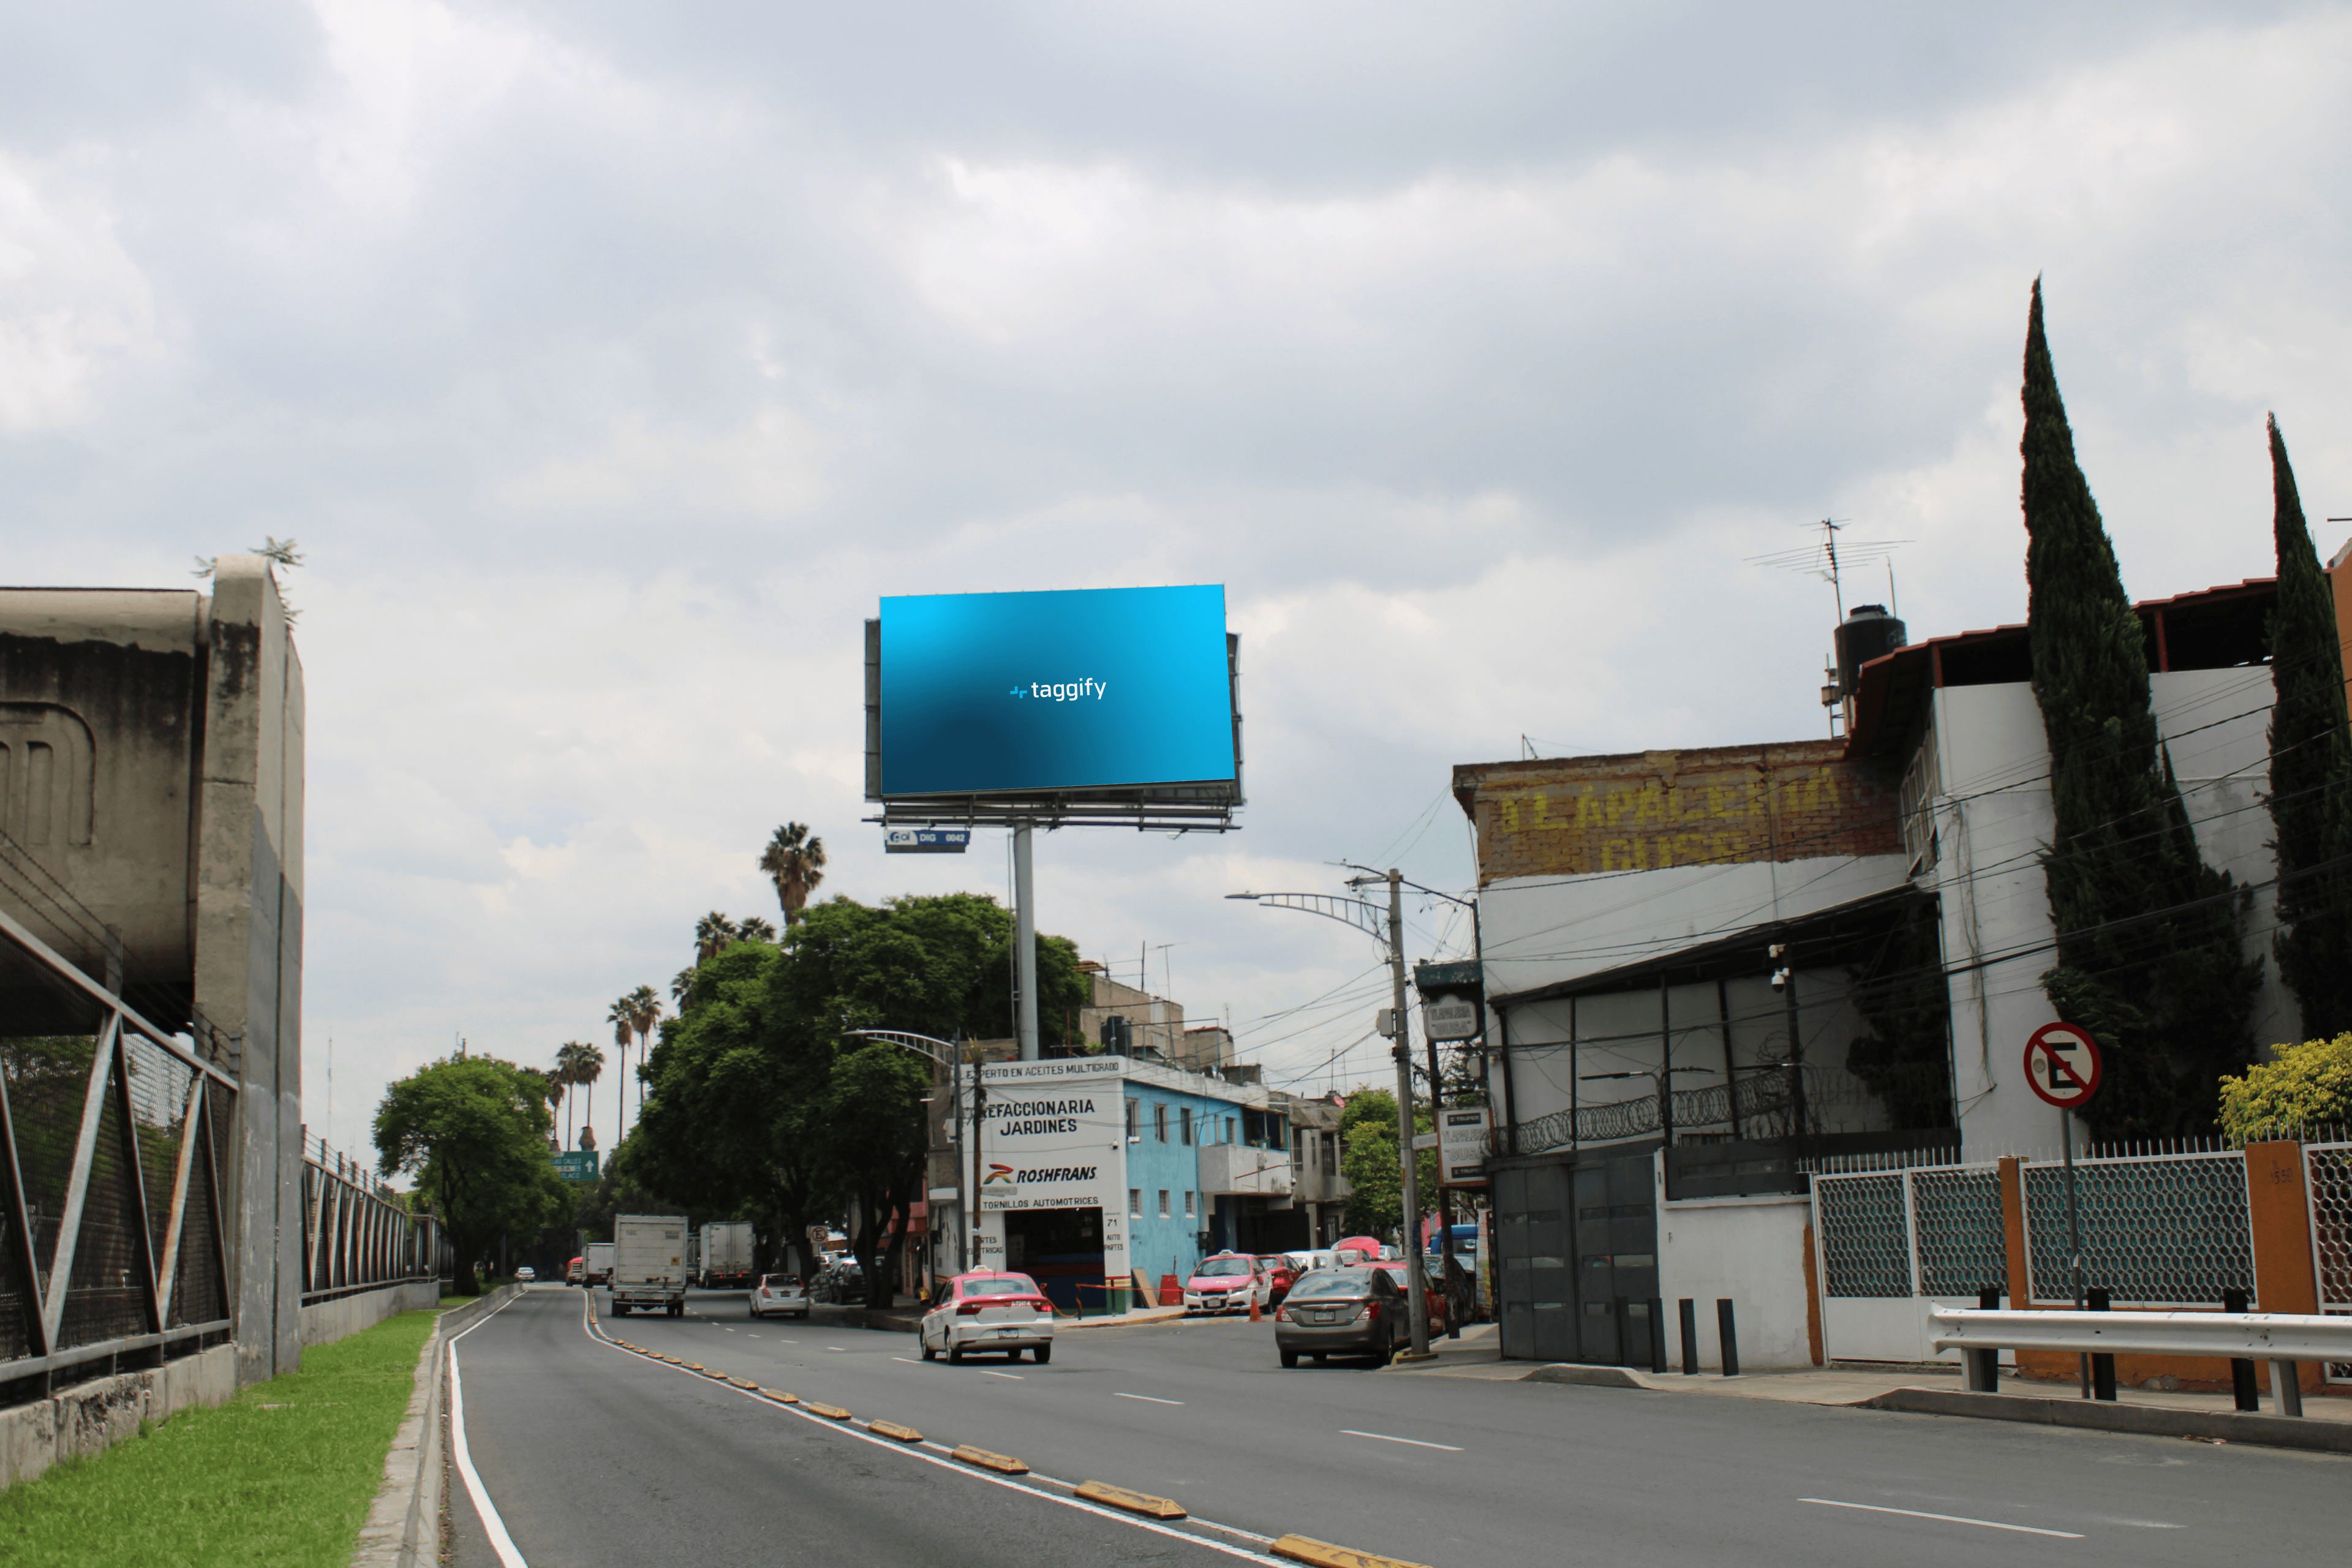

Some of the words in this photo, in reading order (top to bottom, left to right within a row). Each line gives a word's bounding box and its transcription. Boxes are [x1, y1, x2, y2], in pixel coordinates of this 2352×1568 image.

[1031, 677, 1106, 701] taggify
[967, 1068, 1008, 1079] EPERTO
[1011, 1068, 1022, 1077] EN
[1025, 1065, 1063, 1076] ACEITES
[1066, 1062, 1118, 1074] MULTIGRADO
[1000, 1119, 1077, 1136] JARDINES
[1017, 1166, 1098, 1183] ROSHFRANS
[983, 1200, 1028, 1209] TORNILLOS
[1033, 1197, 1099, 1207] AUTOMOTRICES
[967, 1246, 1004, 1256] ELTRICAS
